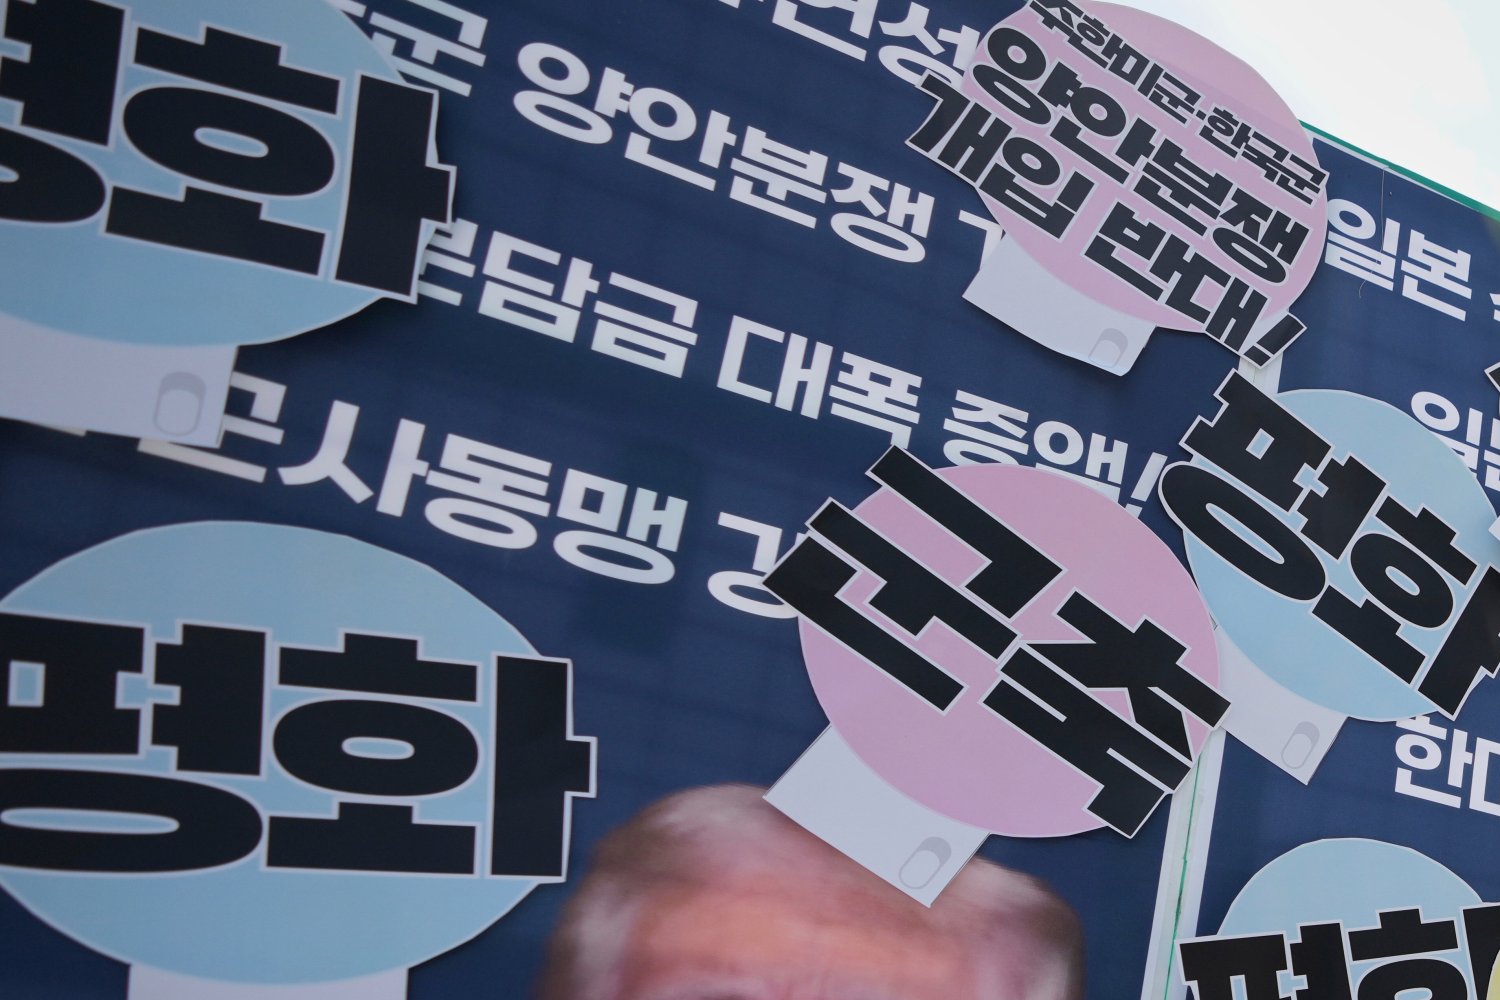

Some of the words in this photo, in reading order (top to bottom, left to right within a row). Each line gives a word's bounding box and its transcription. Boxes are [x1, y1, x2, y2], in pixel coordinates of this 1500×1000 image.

[513, 42, 934, 263] 양안분쟁
[908, 74, 1095, 239] 개입
[1084, 202, 1304, 367] 반대!
[972, 27, 1309, 283] 양안분쟁
[1325, 198, 1471, 321] 일본
[716, 314, 922, 449] 대폭
[0, 611, 591, 878] 평화
[766, 446, 1230, 836] 군축
